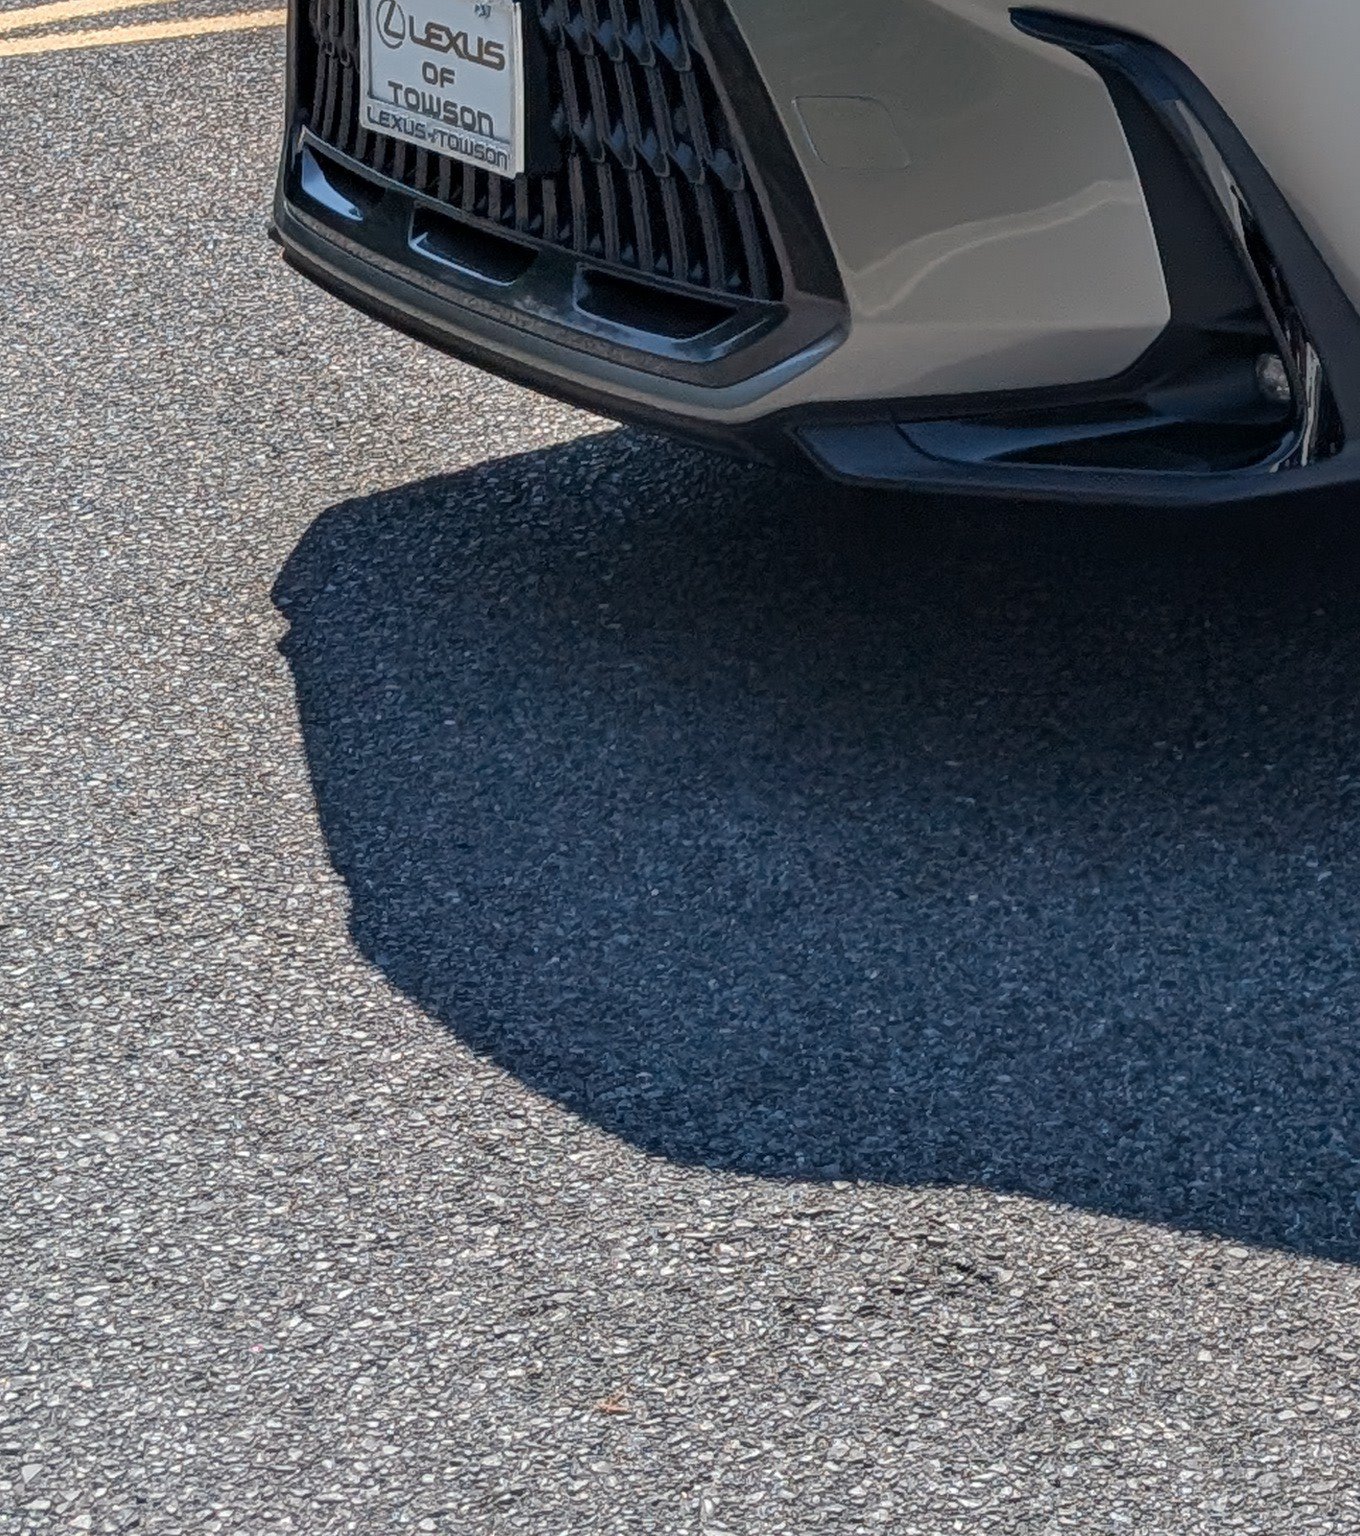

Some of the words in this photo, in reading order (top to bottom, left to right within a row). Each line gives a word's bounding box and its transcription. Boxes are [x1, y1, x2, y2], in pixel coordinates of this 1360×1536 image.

[408, 14, 506, 71] LEXUS
[422, 61, 455, 88] OF
[387, 80, 494, 138] TOWSON
[367, 105, 426, 140] LEXUS
[434, 128, 508, 171] TOWSON
